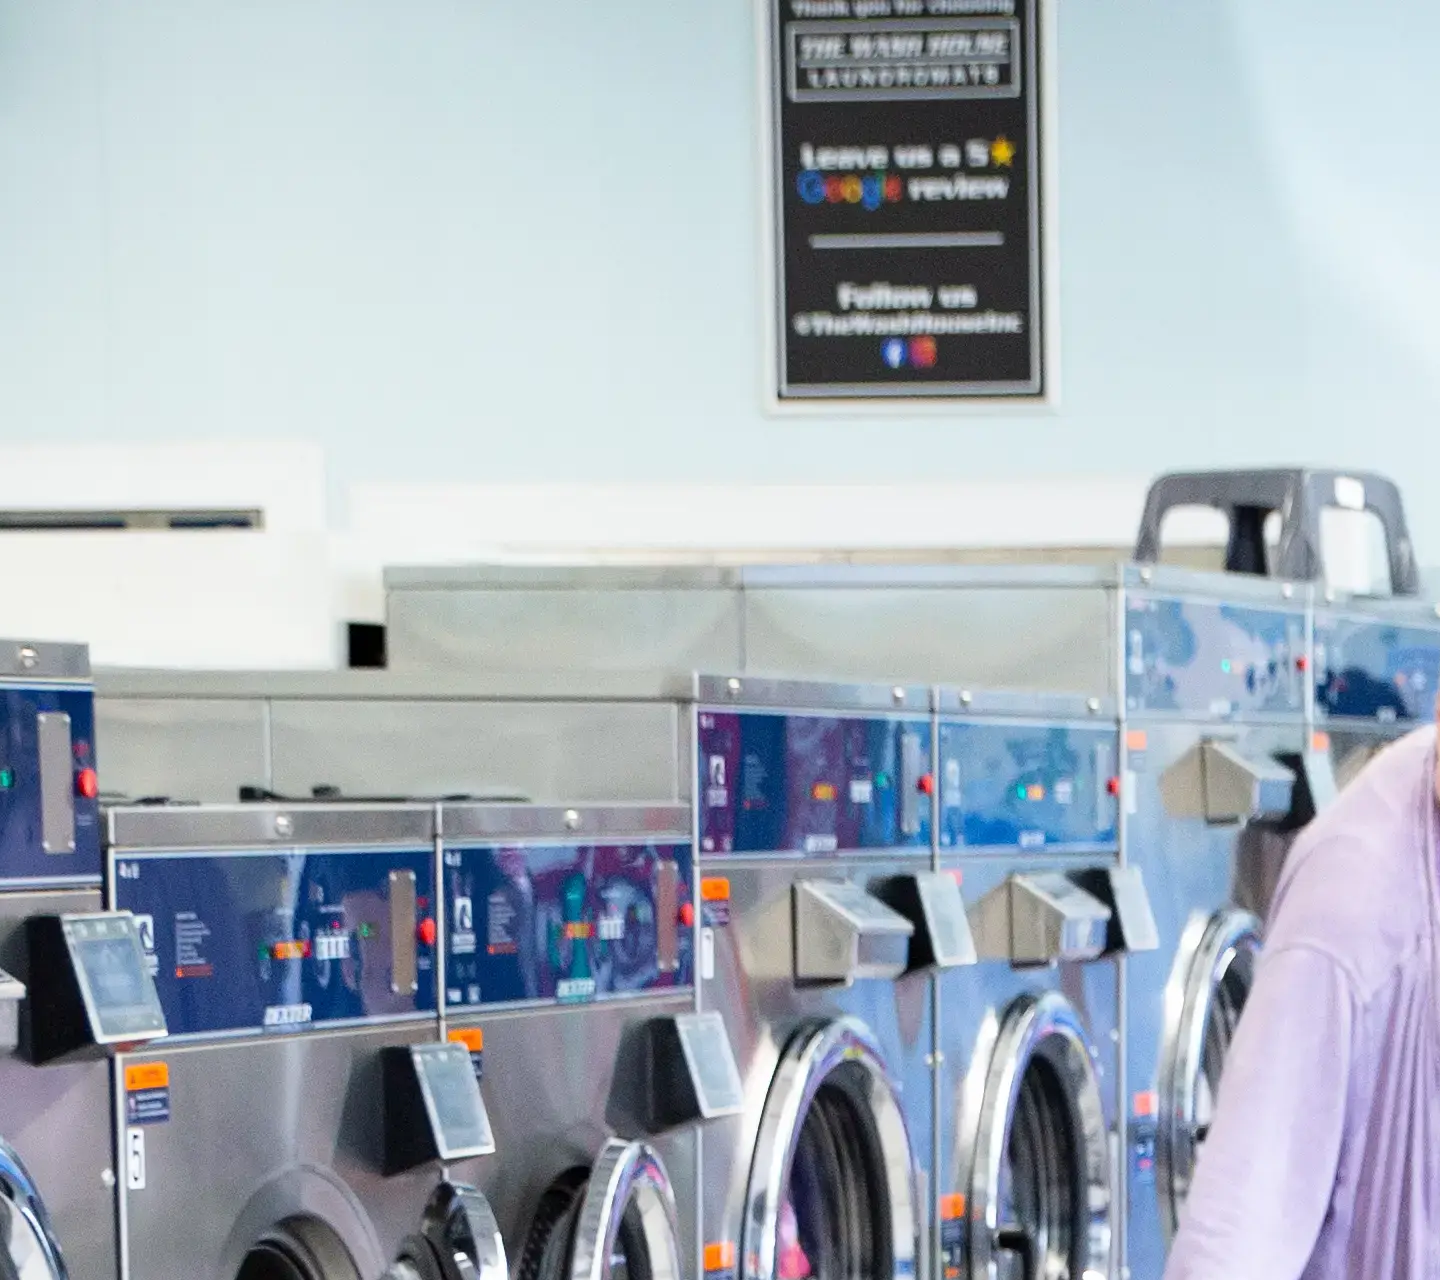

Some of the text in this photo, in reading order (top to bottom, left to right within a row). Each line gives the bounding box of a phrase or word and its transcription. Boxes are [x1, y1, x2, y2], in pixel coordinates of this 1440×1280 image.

[800, 143, 889, 170] Leave
[893, 145, 934, 168] us
[938, 145, 960, 167] a
[798, 170, 1009, 211] Google review
[837, 281, 977, 311] Follow us
[132, 1133, 144, 1182] 5
